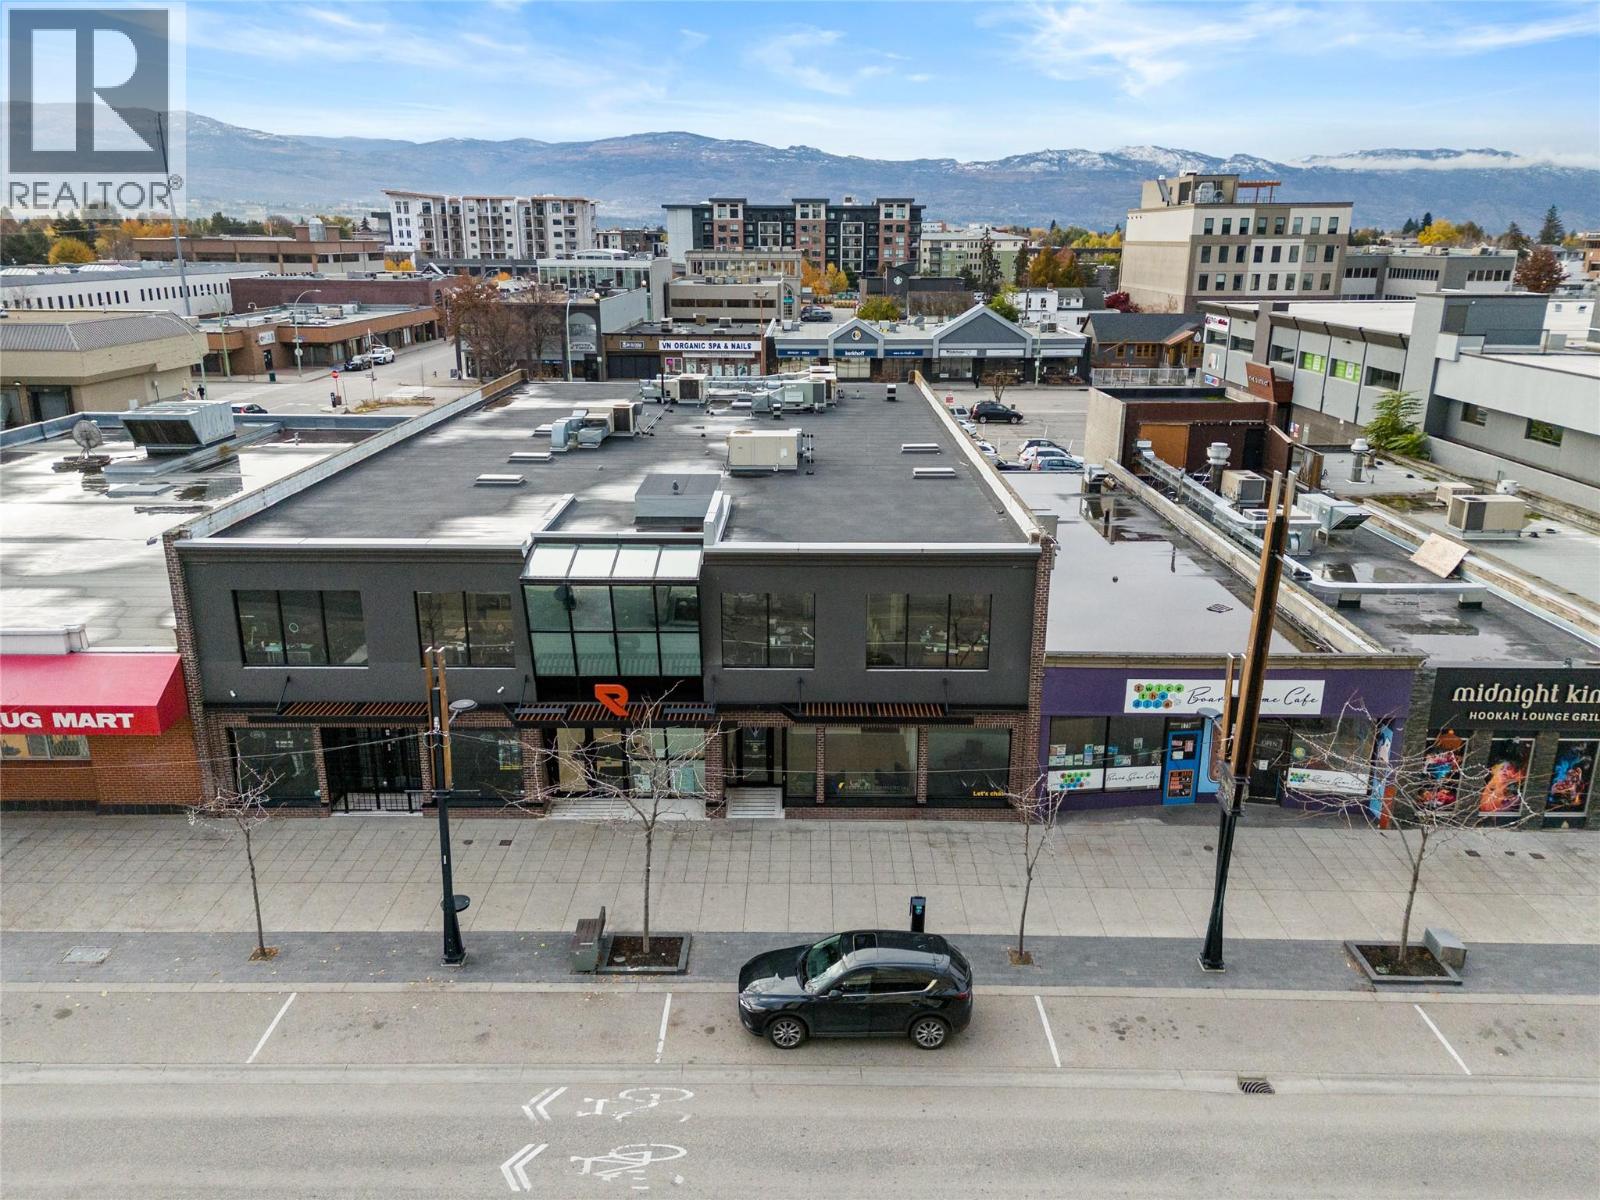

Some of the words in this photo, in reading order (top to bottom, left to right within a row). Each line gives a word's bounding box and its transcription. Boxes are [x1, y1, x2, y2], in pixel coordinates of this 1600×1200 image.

[1136, 684, 1182, 692] twice
[1186, 686, 1224, 704] Boar
[1284, 686, 1319, 706] Cafe
[1451, 683, 1560, 709] midnight
[0, 712, 43, 728] UG
[52, 713, 134, 728] MART
[1469, 711, 1519, 721] HOOKAH
[1522, 712, 1570, 721] LOUNGE
[1572, 713, 1600, 722] GRIL
